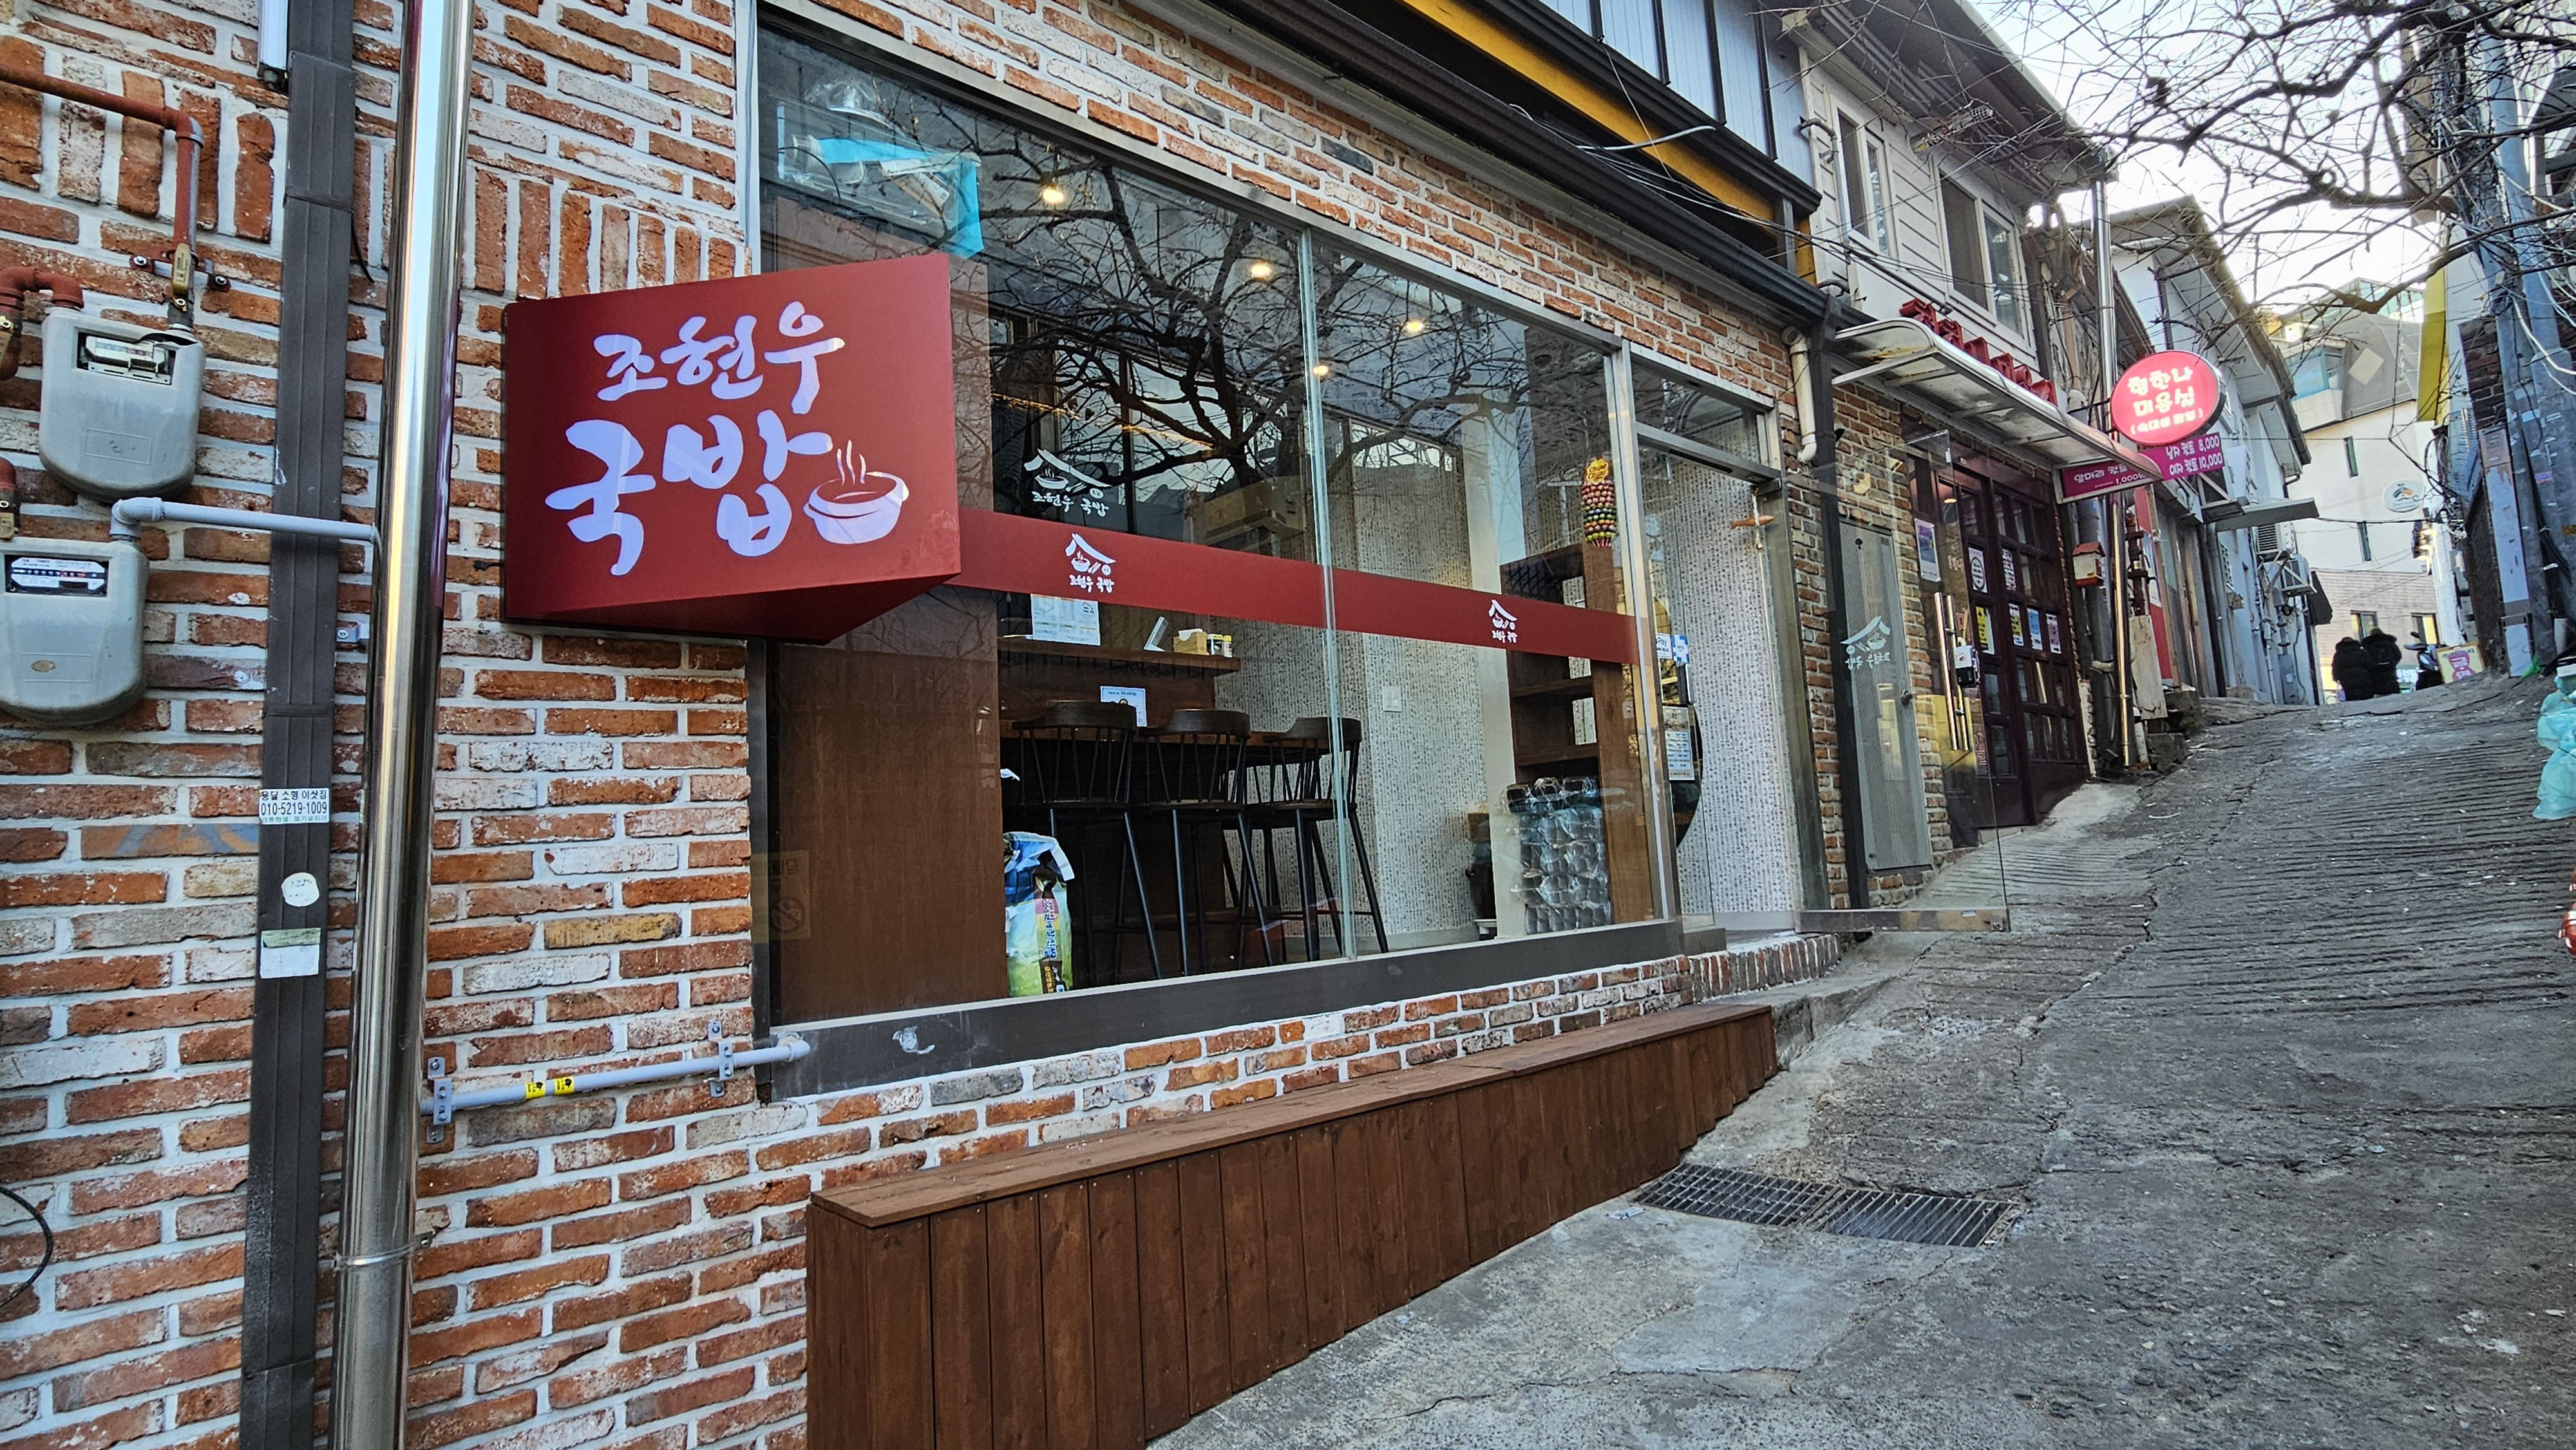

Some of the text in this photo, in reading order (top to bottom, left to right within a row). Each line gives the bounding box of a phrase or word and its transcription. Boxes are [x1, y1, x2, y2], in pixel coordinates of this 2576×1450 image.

[593, 301, 846, 414] 조현우
[2133, 386, 2195, 417] 미용실
[2198, 435, 2220, 452] 8,000
[2199, 452, 2223, 469] 10,000
[2074, 469, 2105, 483] 앞머리
[544, 410, 834, 576] 국밥
[1032, 491, 1109, 517] 조현우 국밥
[1069, 574, 1115, 593] 조현우 국밥
[260, 791, 278, 801] 용달
[301, 789, 327, 800] 이삿짐
[261, 801, 327, 816] 010-5219-1009
